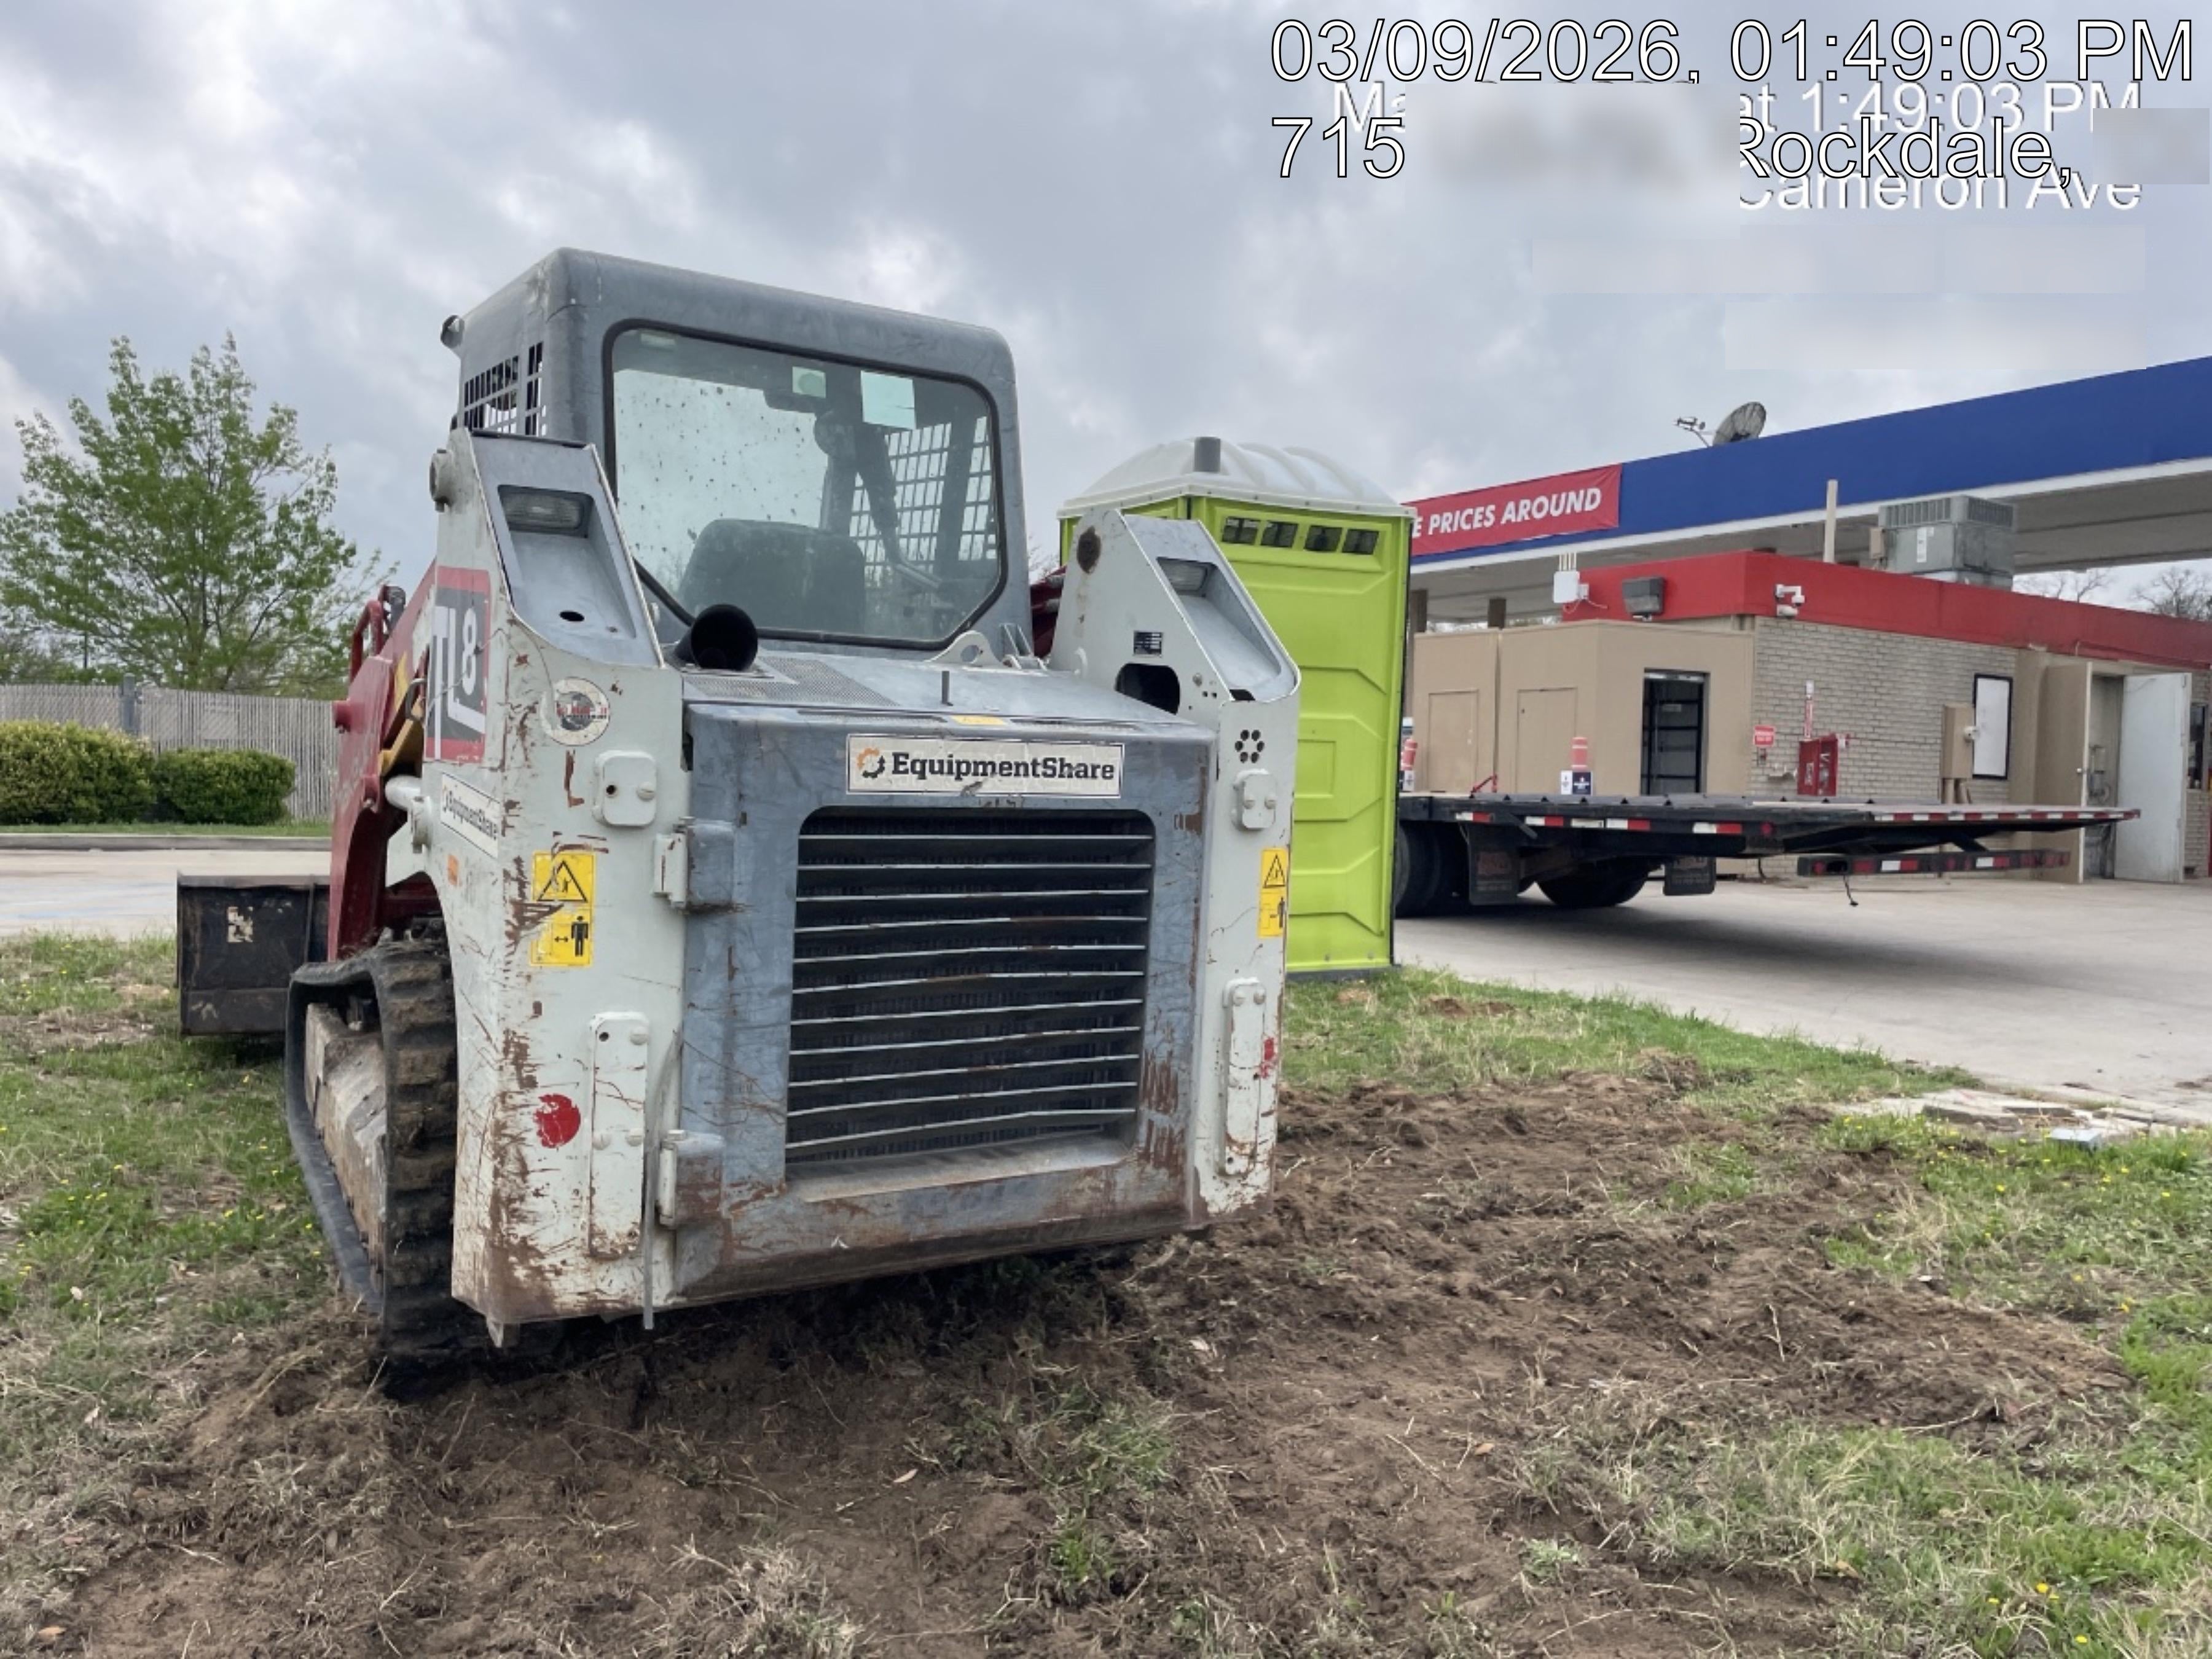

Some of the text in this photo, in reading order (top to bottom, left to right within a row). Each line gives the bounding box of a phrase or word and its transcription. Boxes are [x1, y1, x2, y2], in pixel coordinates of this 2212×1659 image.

[1428, 504, 1496, 536] PRICES
[1500, 488, 1602, 525] AROUND
[892, 751, 1115, 780] EquipmentShare
